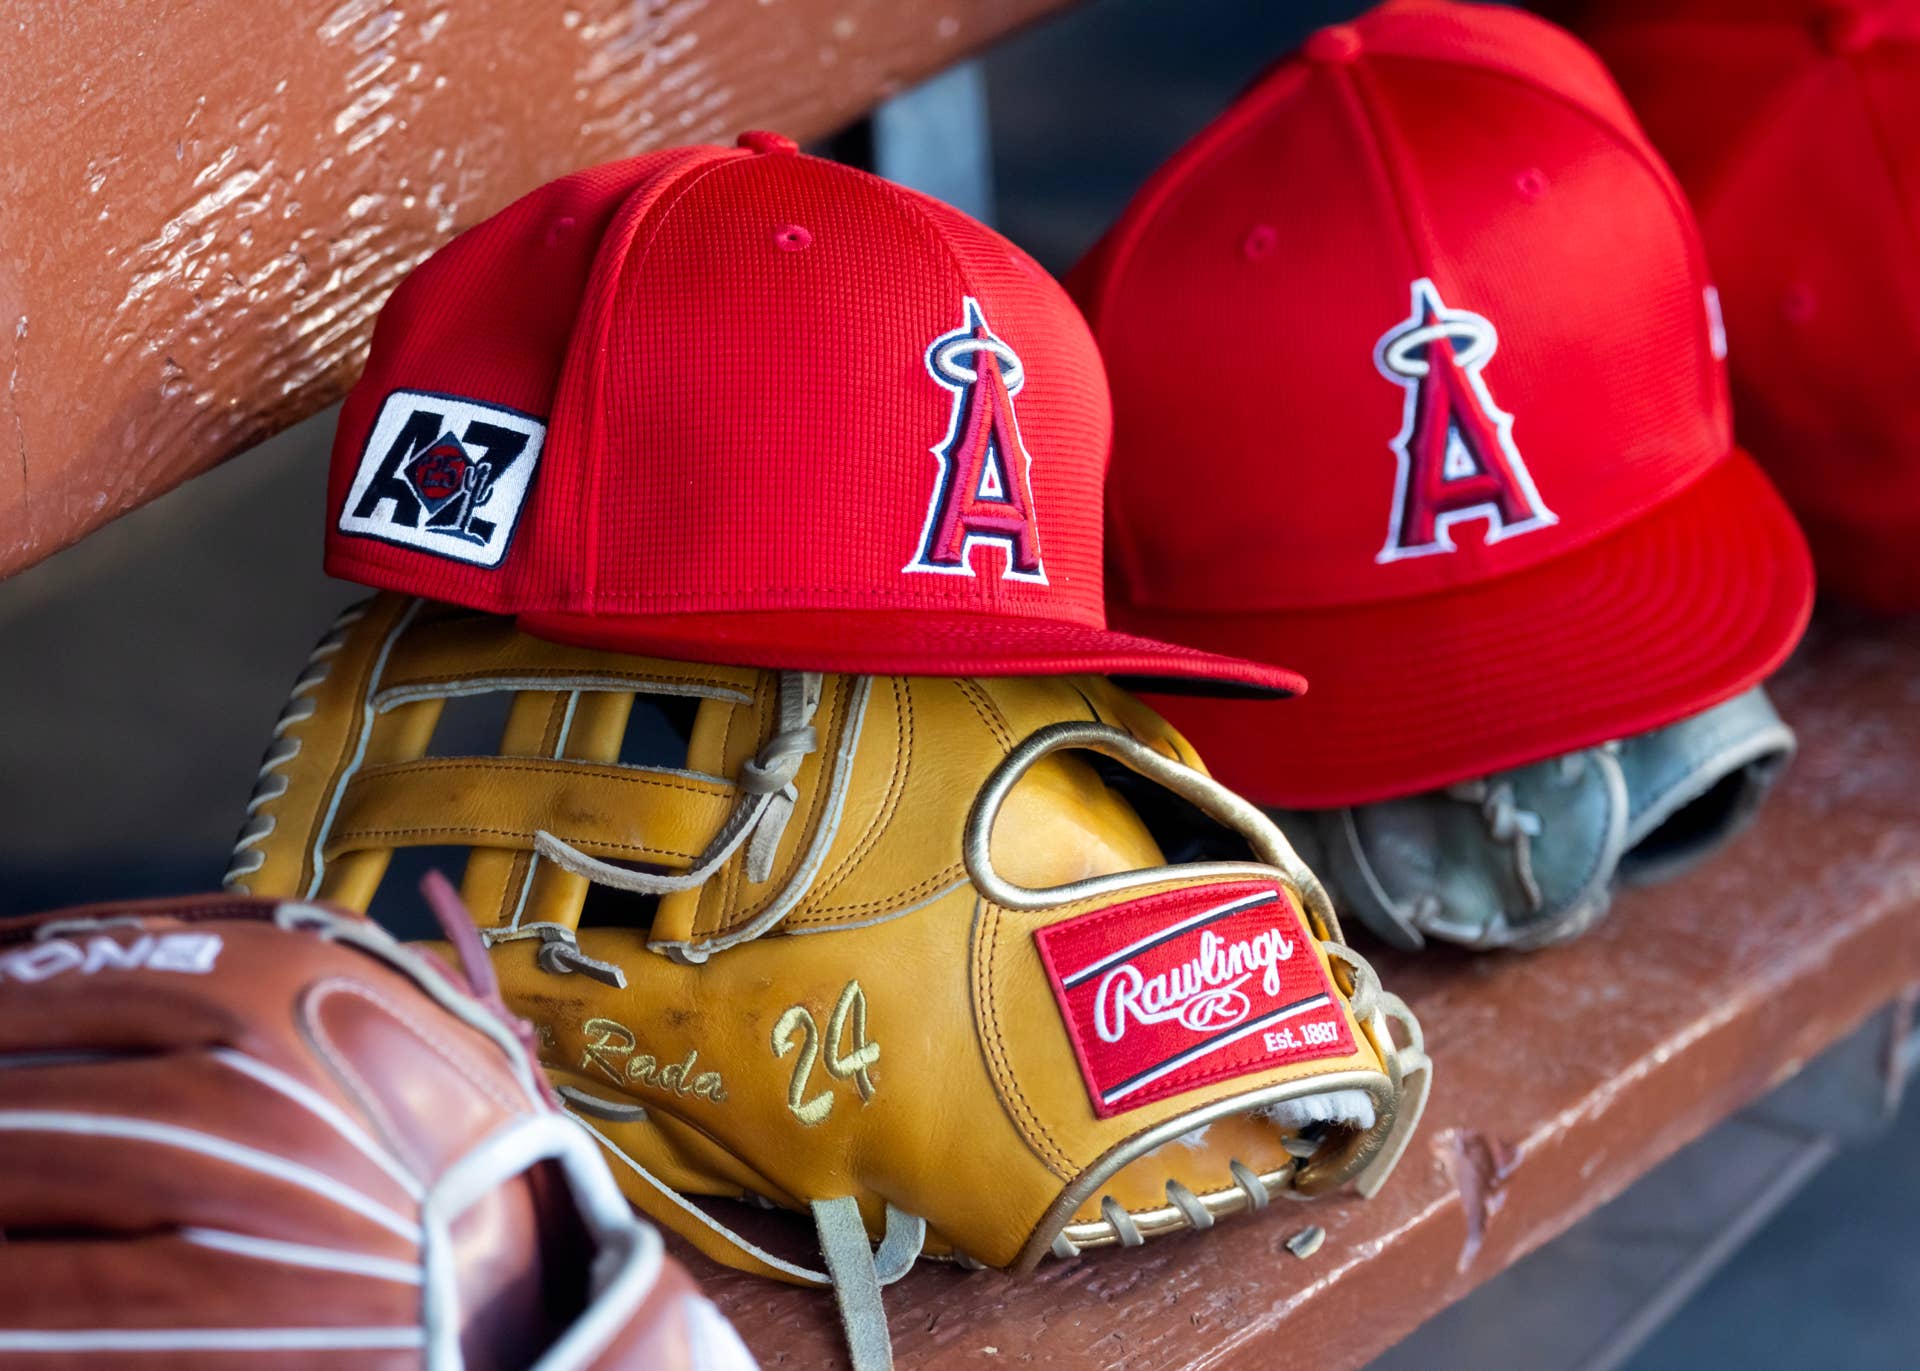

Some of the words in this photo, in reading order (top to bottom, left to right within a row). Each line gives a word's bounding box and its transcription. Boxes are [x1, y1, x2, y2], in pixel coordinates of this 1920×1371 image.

[352, 409, 531, 546] AZ
[902, 296, 1049, 586] A
[1373, 277, 1559, 564] A
[770, 979, 881, 1127] 24
[1094, 929, 1293, 1042] Rawlings
[1263, 1030, 1302, 1053] Est.
[1302, 1021, 1339, 1045] 1887
[579, 1017, 727, 1102] Rada
